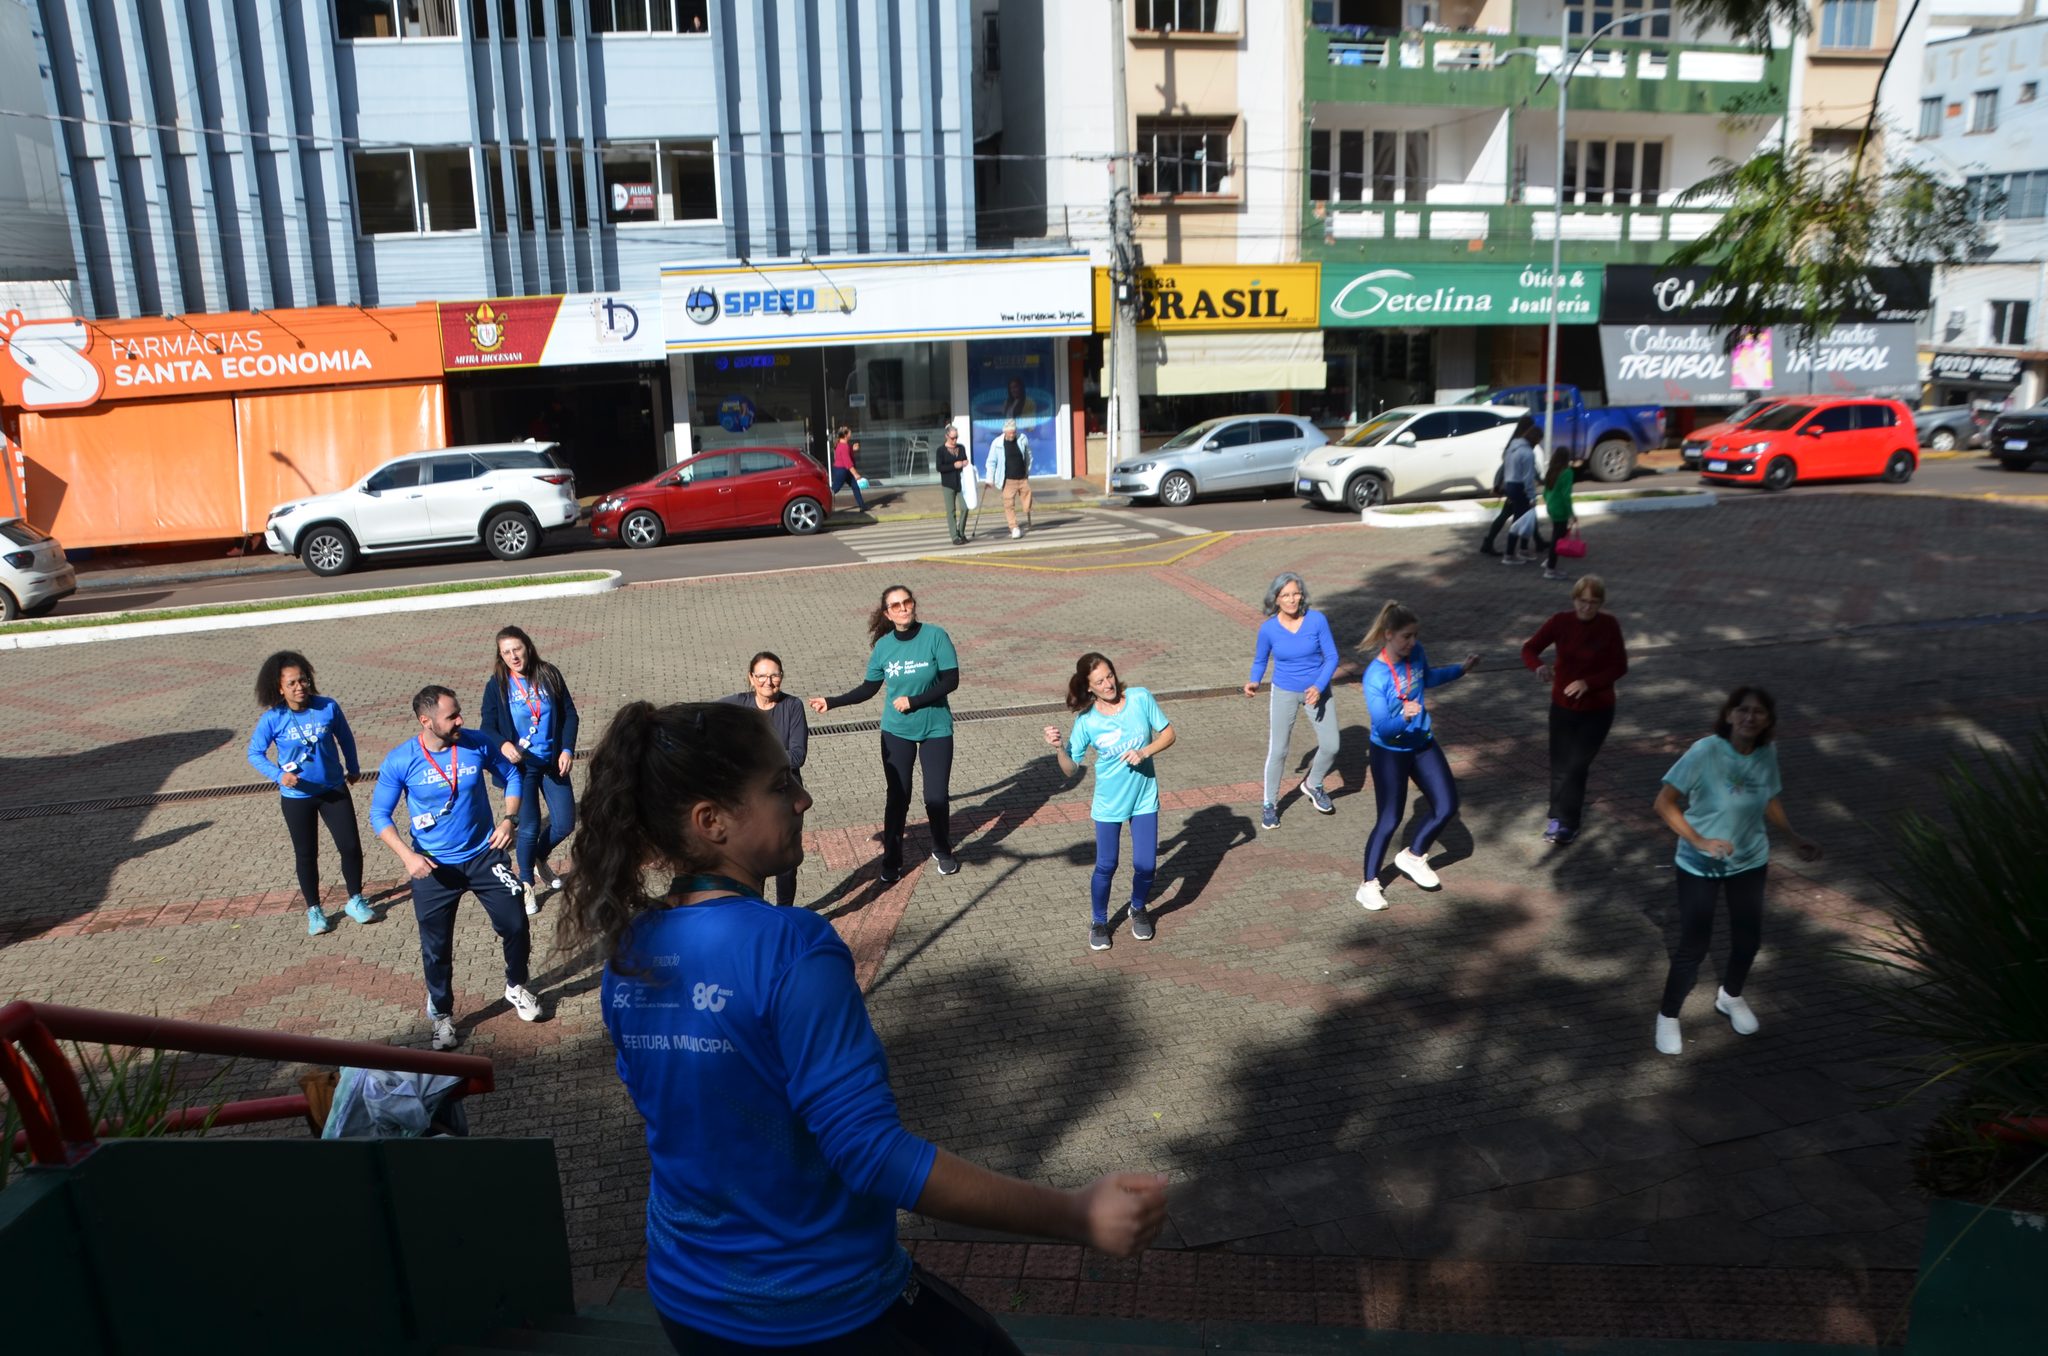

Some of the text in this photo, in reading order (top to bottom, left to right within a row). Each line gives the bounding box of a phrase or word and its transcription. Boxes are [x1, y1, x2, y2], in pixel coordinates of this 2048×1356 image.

[1569, 270, 1586, 288] &
[110, 329, 263, 360] FARMÁCIAS
[114, 348, 372, 386] SANTA ECONOMIA
[1618, 353, 1726, 380] TREVISOL
